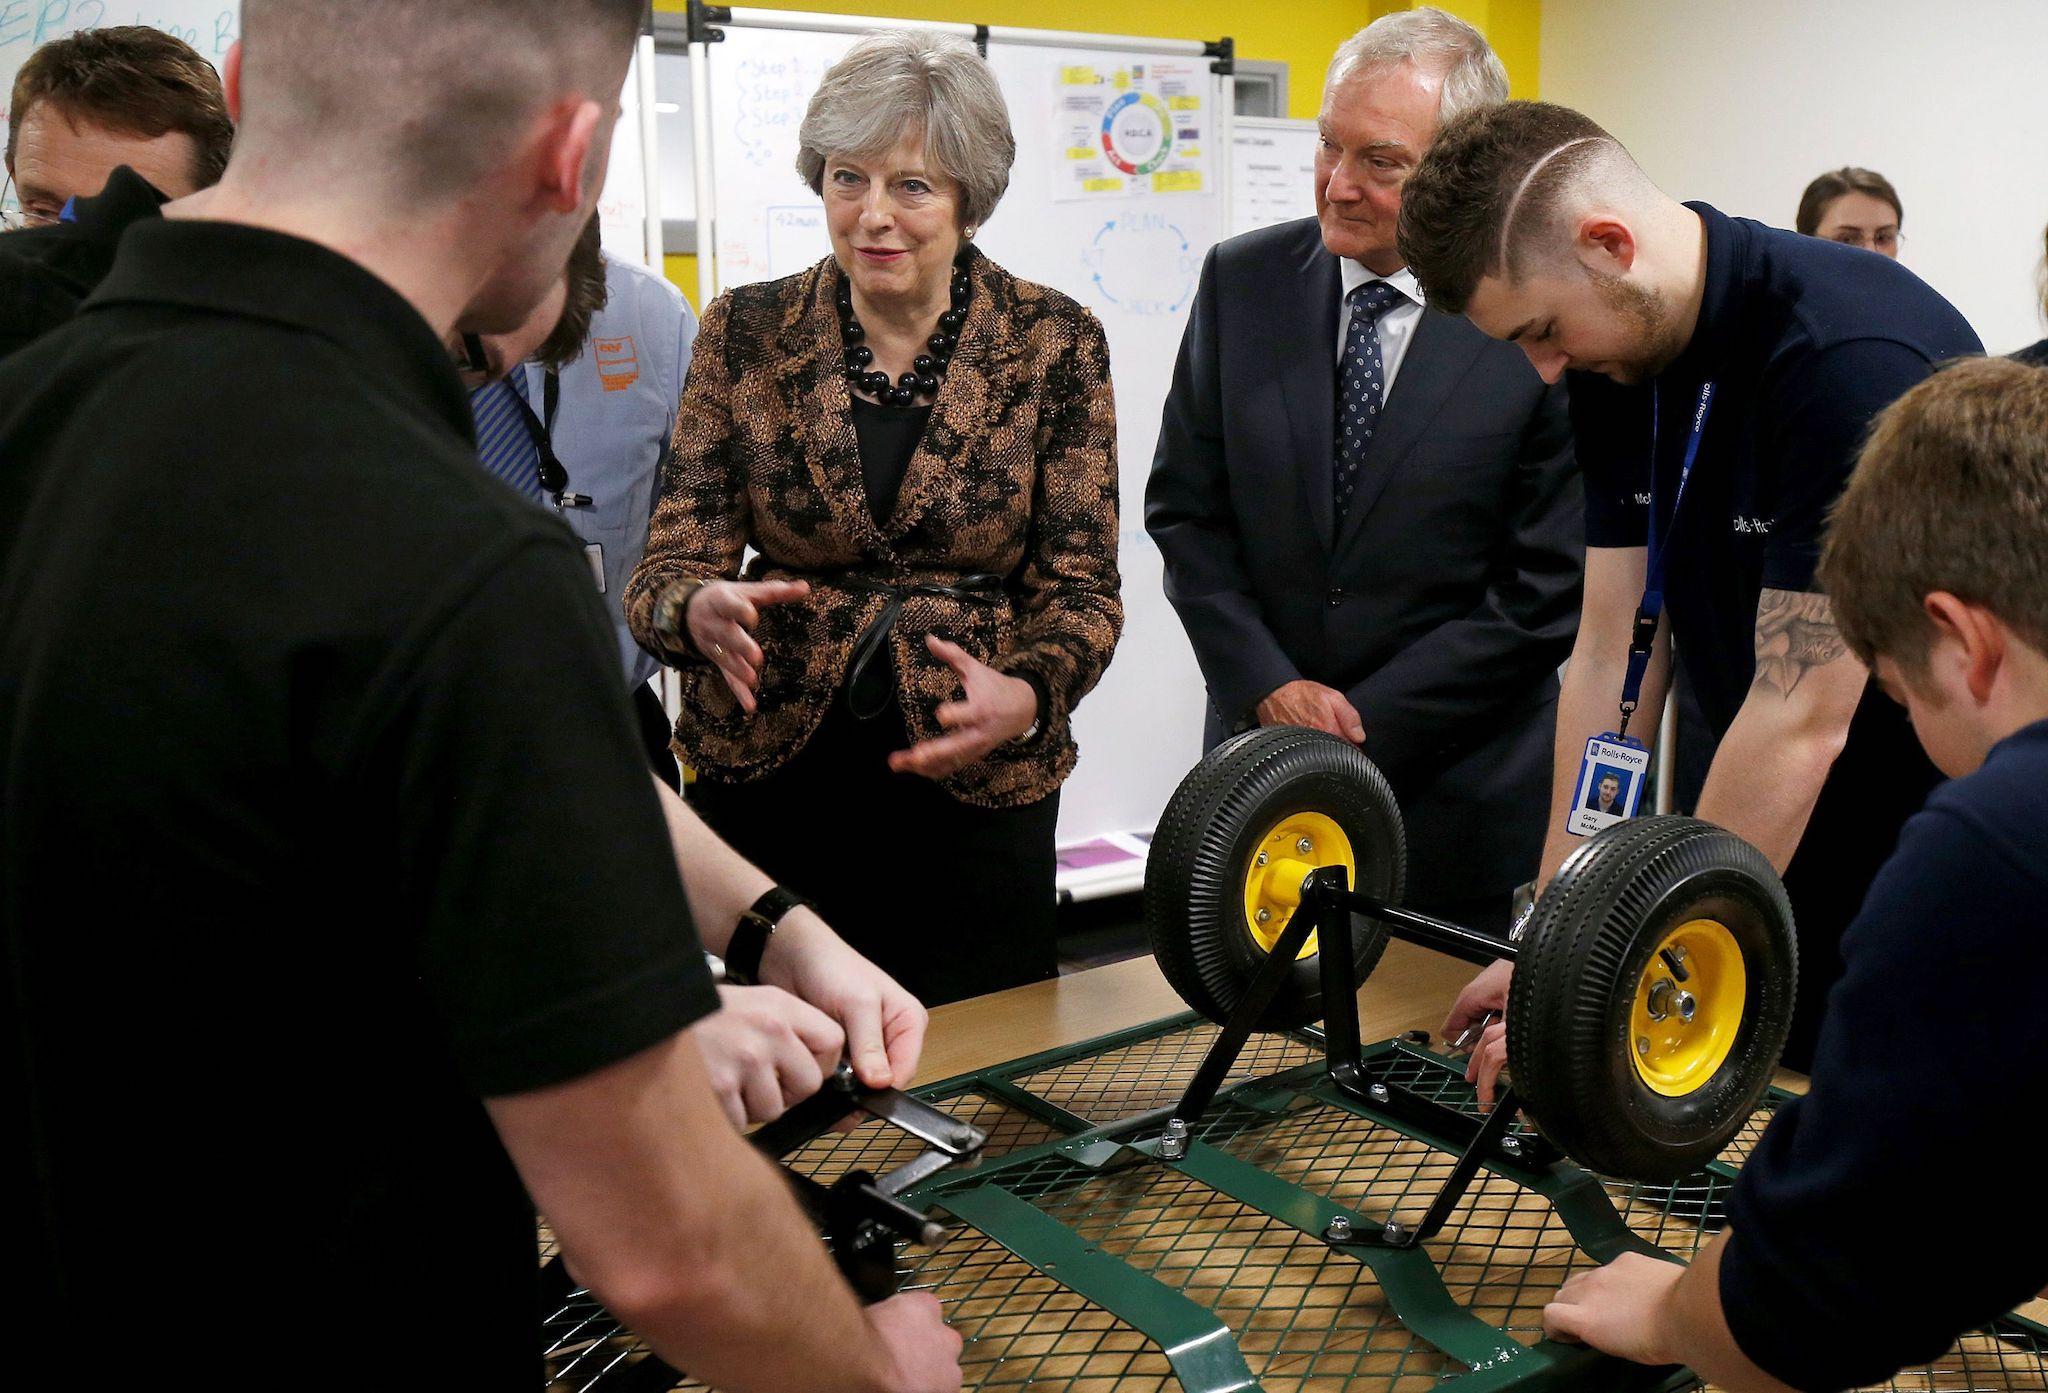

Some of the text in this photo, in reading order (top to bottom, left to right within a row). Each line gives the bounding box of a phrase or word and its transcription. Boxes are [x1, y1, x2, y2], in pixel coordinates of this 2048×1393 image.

[1694, 382, 1712, 433] olls-Royce
[1601, 748, 1642, 764] Rolls-Royce
[1583, 814, 1597, 823] Gary
[1580, 822, 1604, 832] McMan
